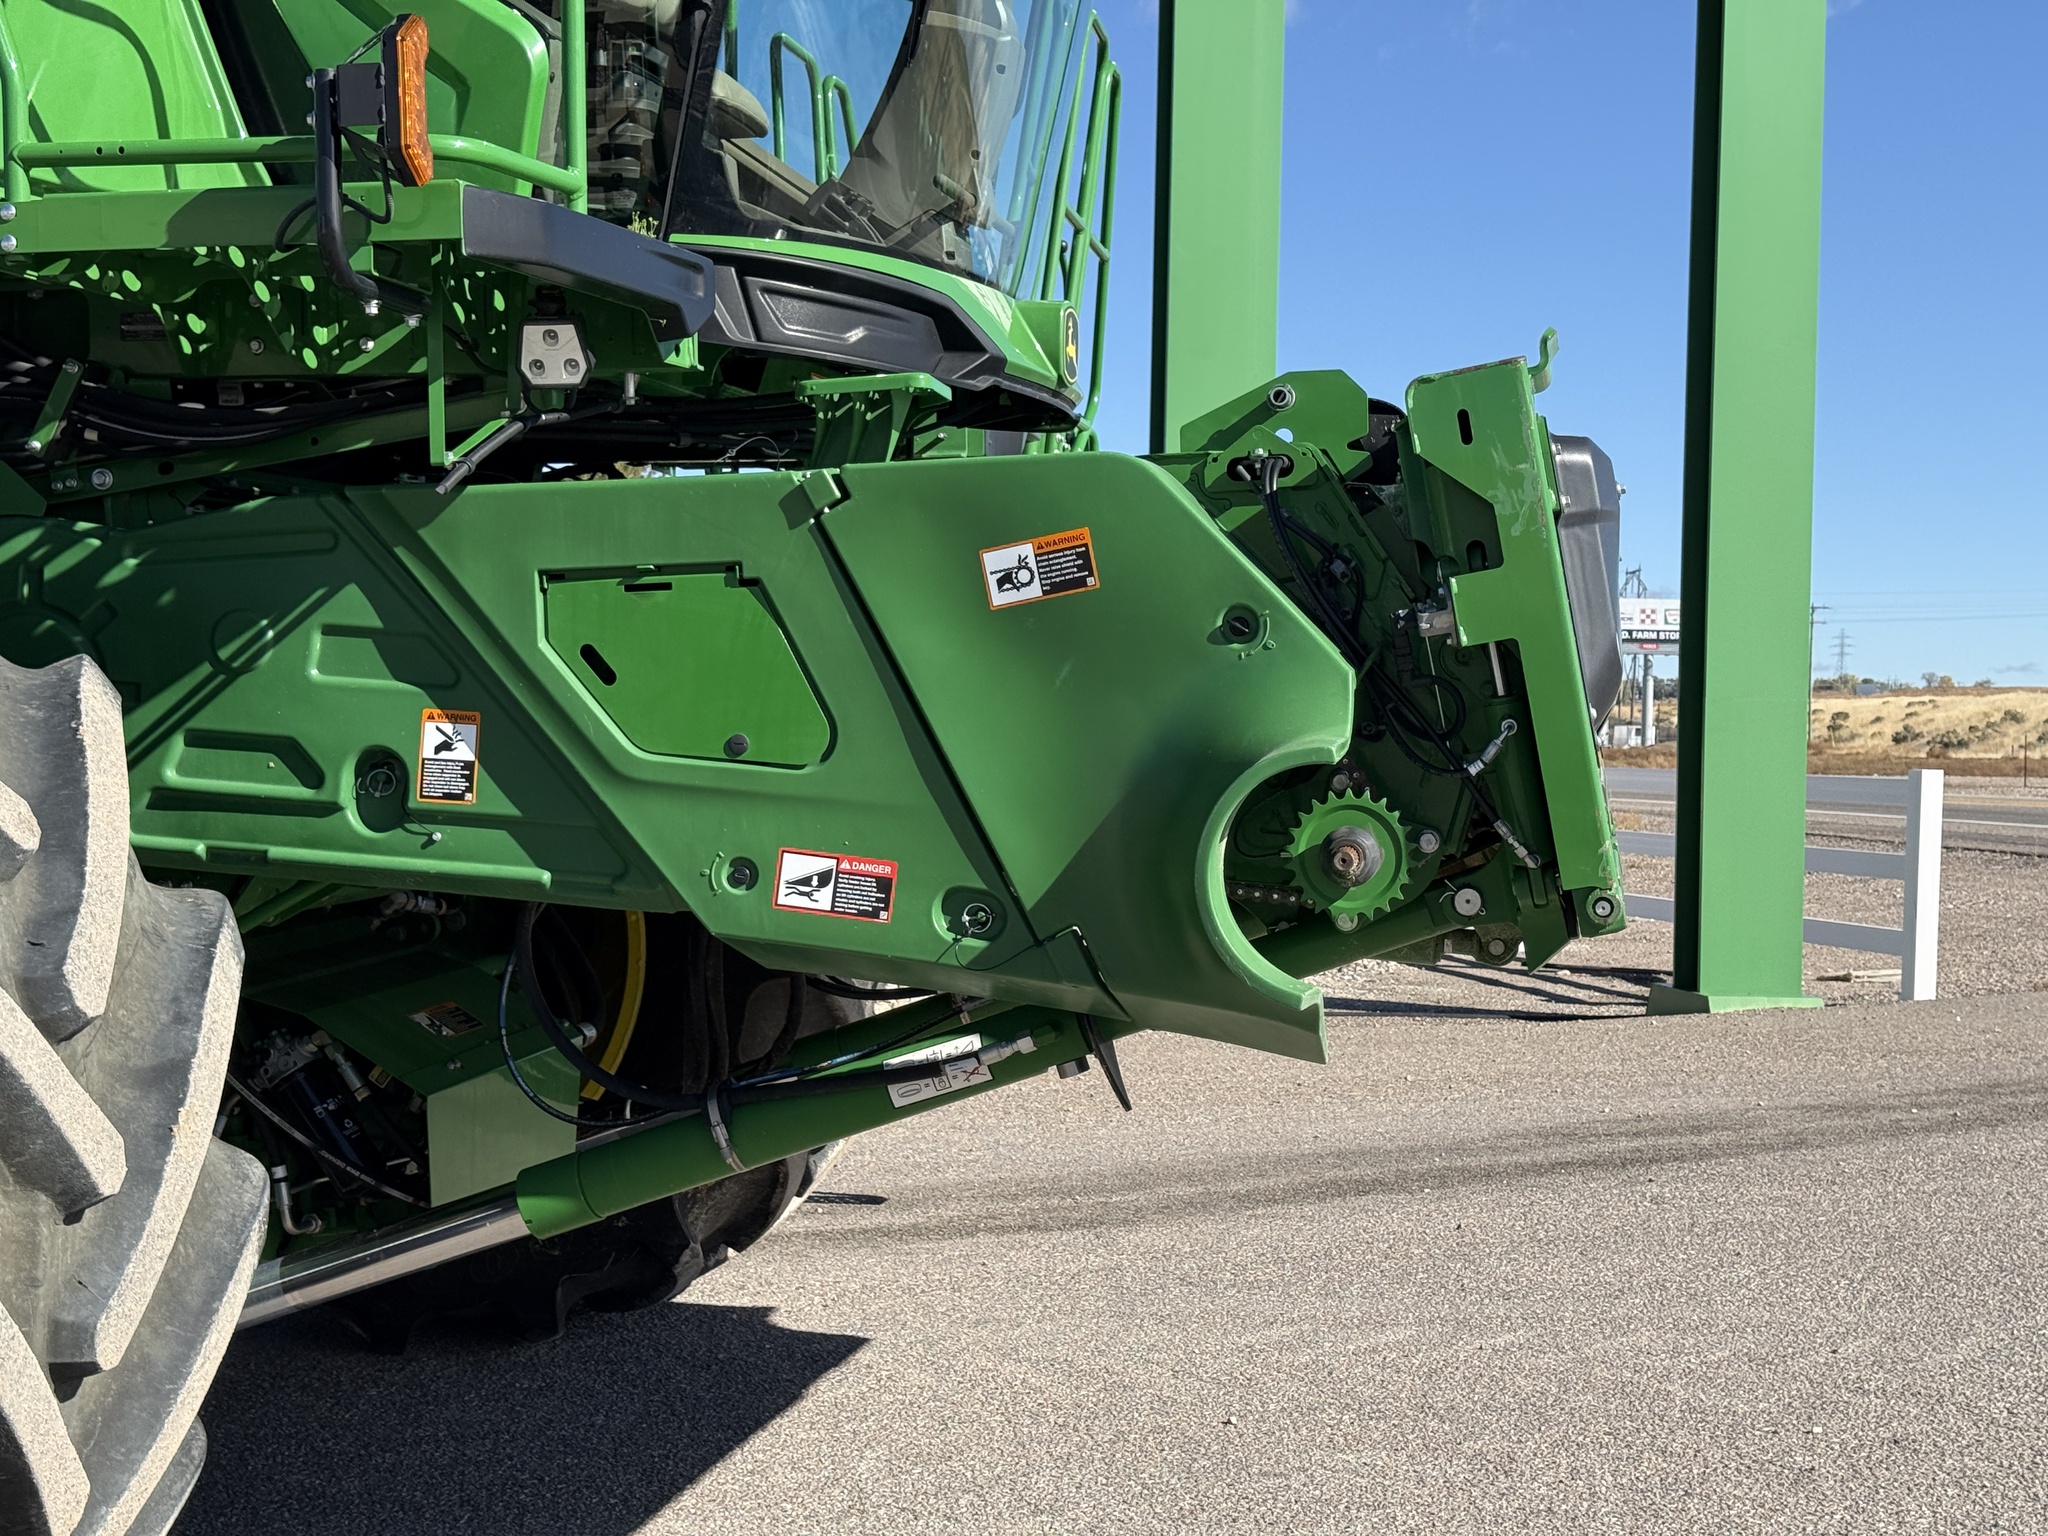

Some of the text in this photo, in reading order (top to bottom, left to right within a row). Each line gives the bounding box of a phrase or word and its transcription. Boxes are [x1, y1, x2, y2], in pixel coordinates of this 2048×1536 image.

[1044, 533, 1086, 548] WARNING
[1632, 631, 1657, 639] FARM
[437, 712, 476, 722] WARNING
[852, 862, 891, 874] DANGER
